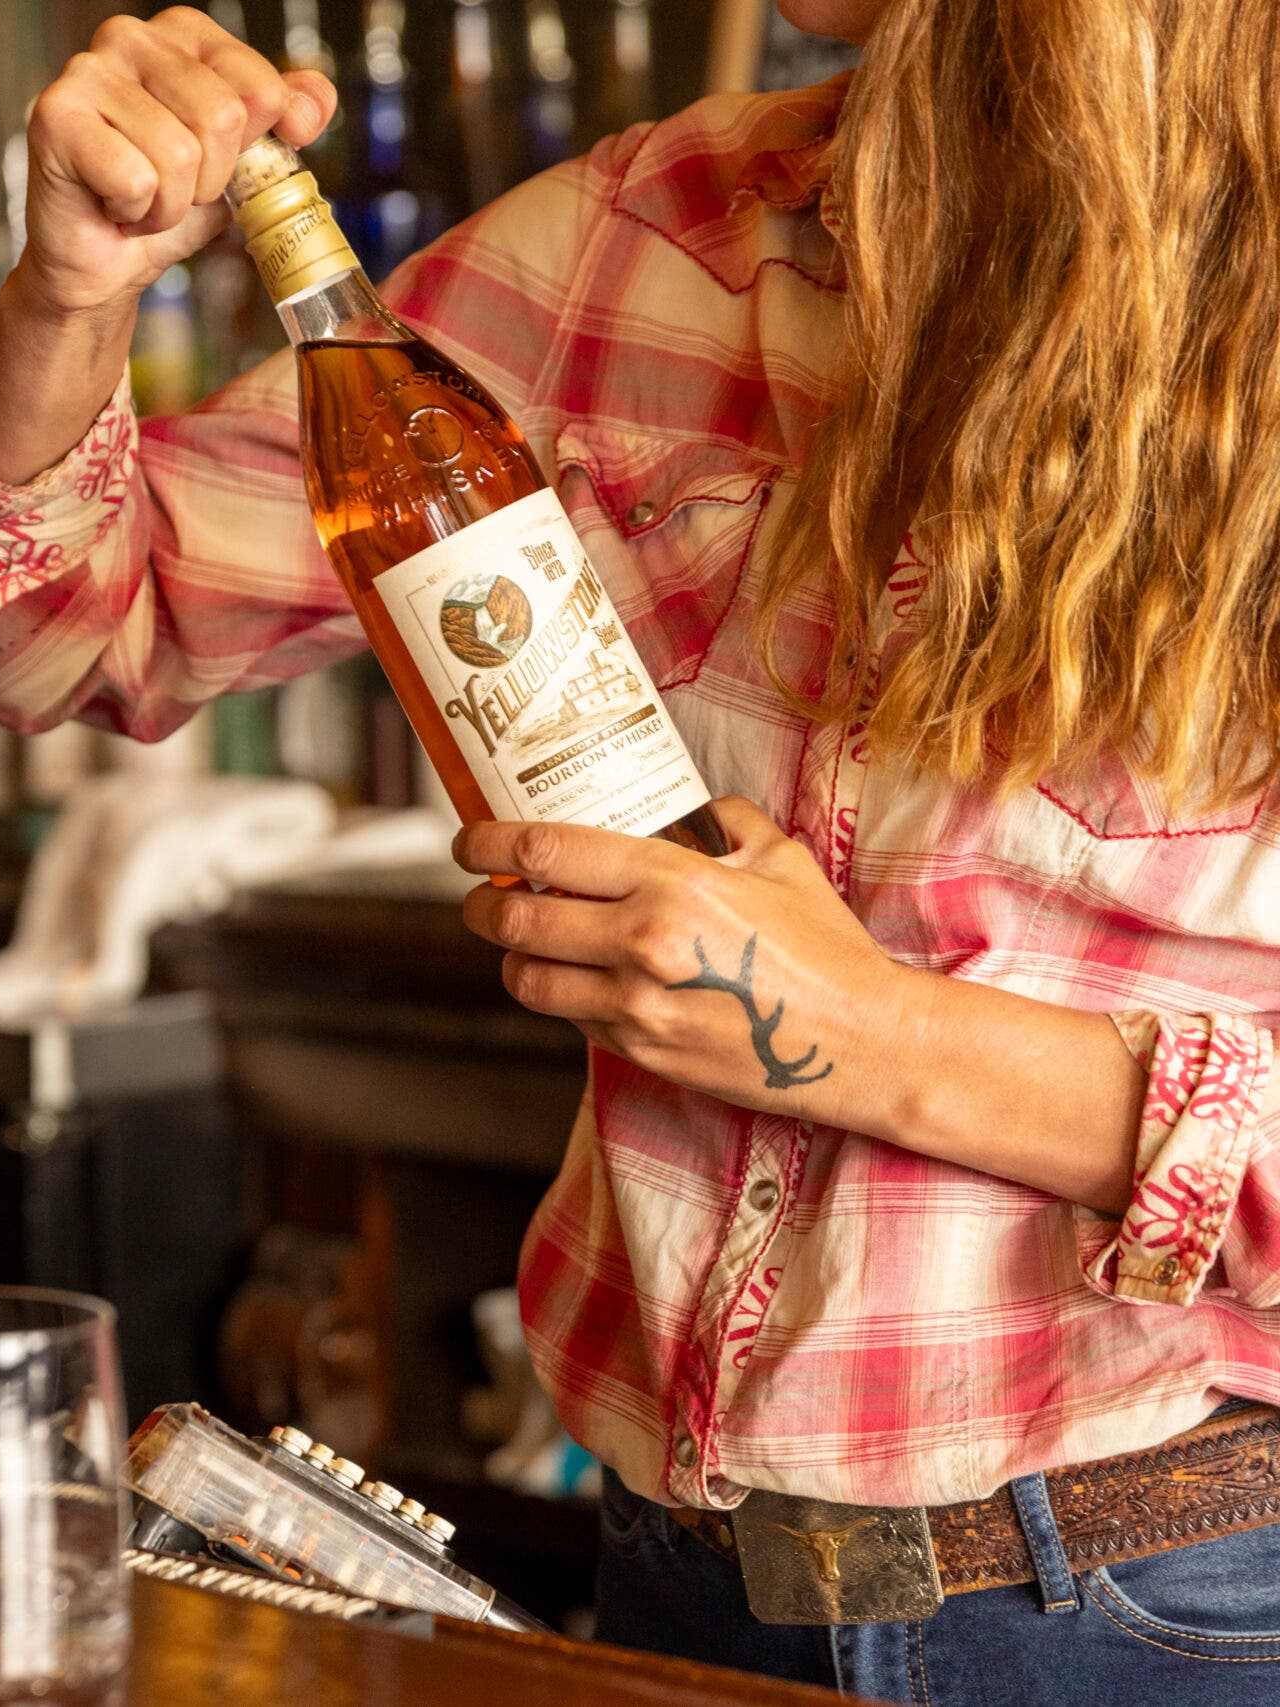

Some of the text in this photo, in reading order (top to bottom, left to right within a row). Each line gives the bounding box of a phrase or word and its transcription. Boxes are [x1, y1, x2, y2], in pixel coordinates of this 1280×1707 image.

[521, 540, 558, 571] Since
[542, 559, 567, 582] 1872
[445, 557, 602, 758] YELLOWSTONE
[525, 747, 607, 798] BOURBON
[610, 717, 665, 751] WHISKEY
[536, 736, 600, 772] KENTUCKY
